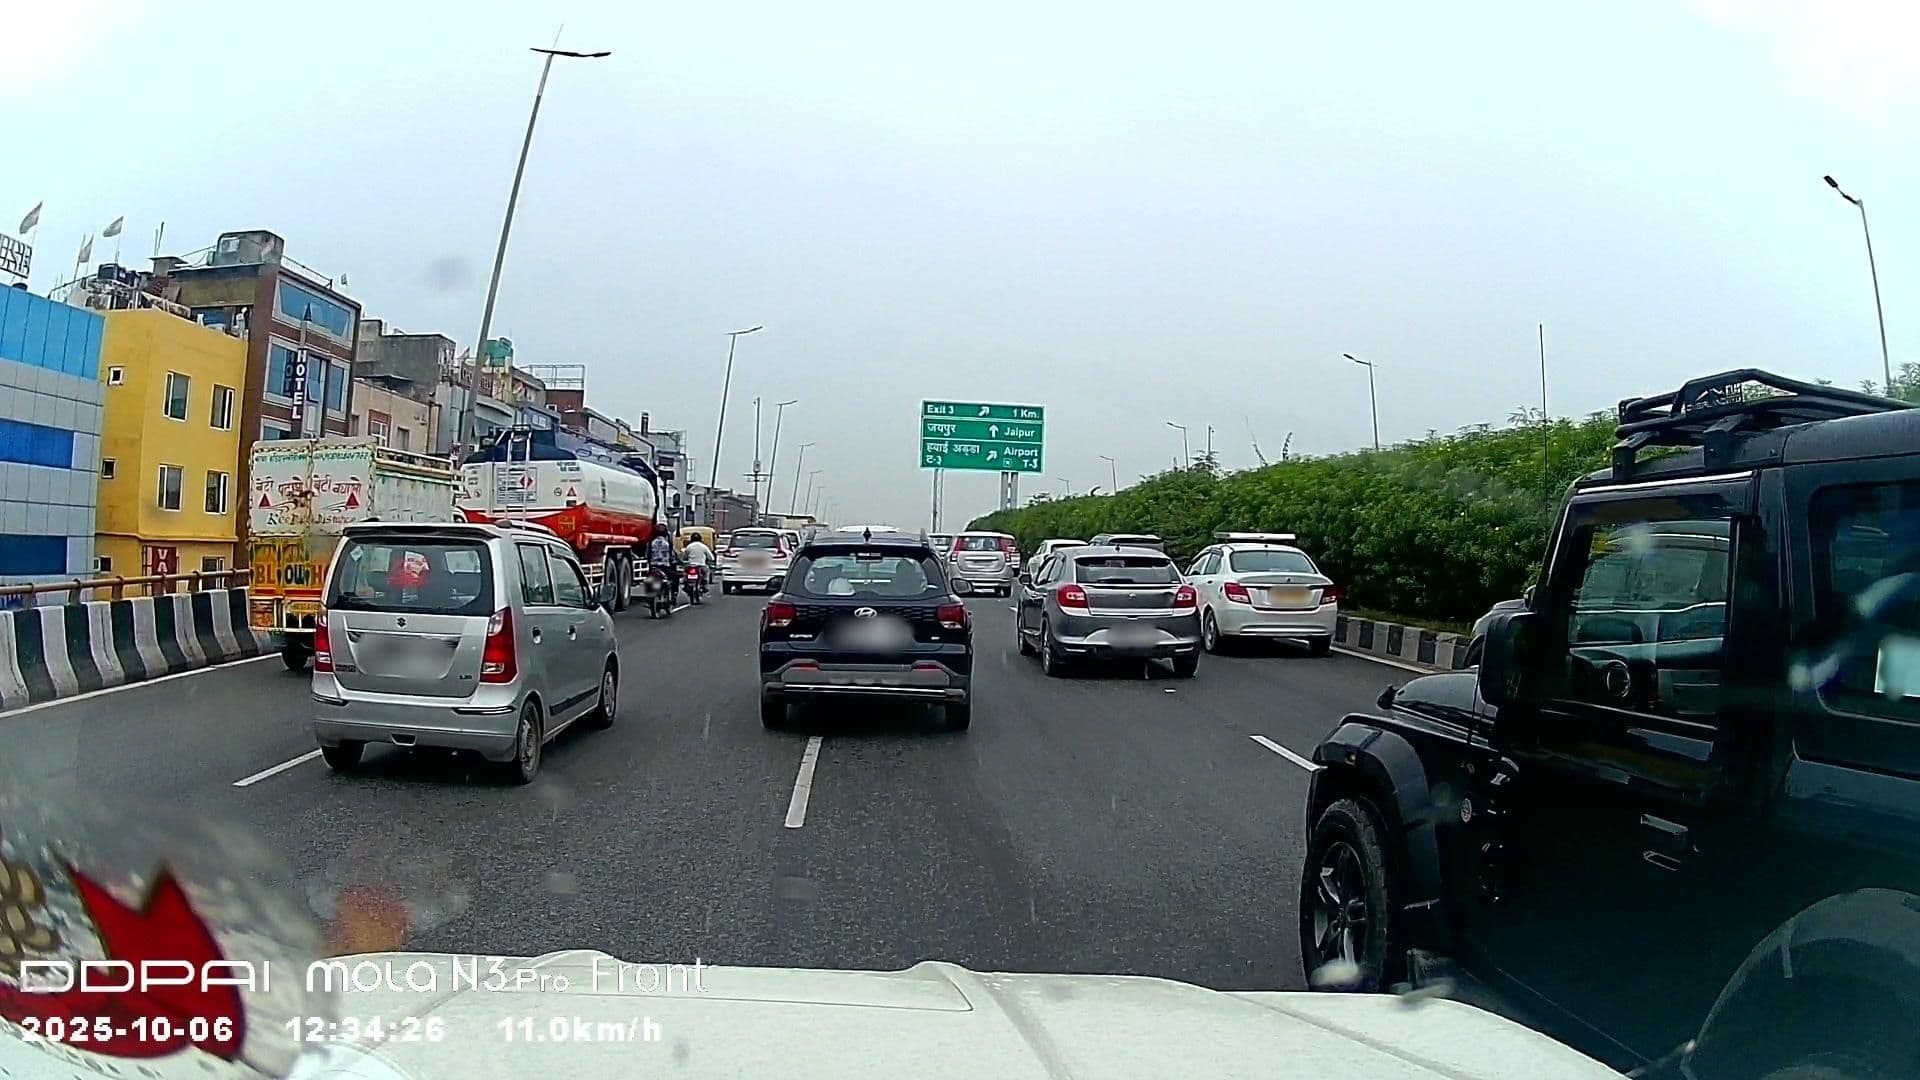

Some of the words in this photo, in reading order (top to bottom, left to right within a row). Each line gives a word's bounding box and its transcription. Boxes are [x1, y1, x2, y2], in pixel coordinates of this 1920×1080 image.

[291, 349, 307, 419] HOTEL
[927, 404, 946, 414] Exit
[948, 405, 955, 415] 3
[1012, 407, 1018, 418] 1
[926, 423, 956, 437] जयपुर
[1003, 427, 1036, 439] Jaipur
[1003, 446, 1039, 458] Airport
[1022, 458, 1039, 469] T-3
